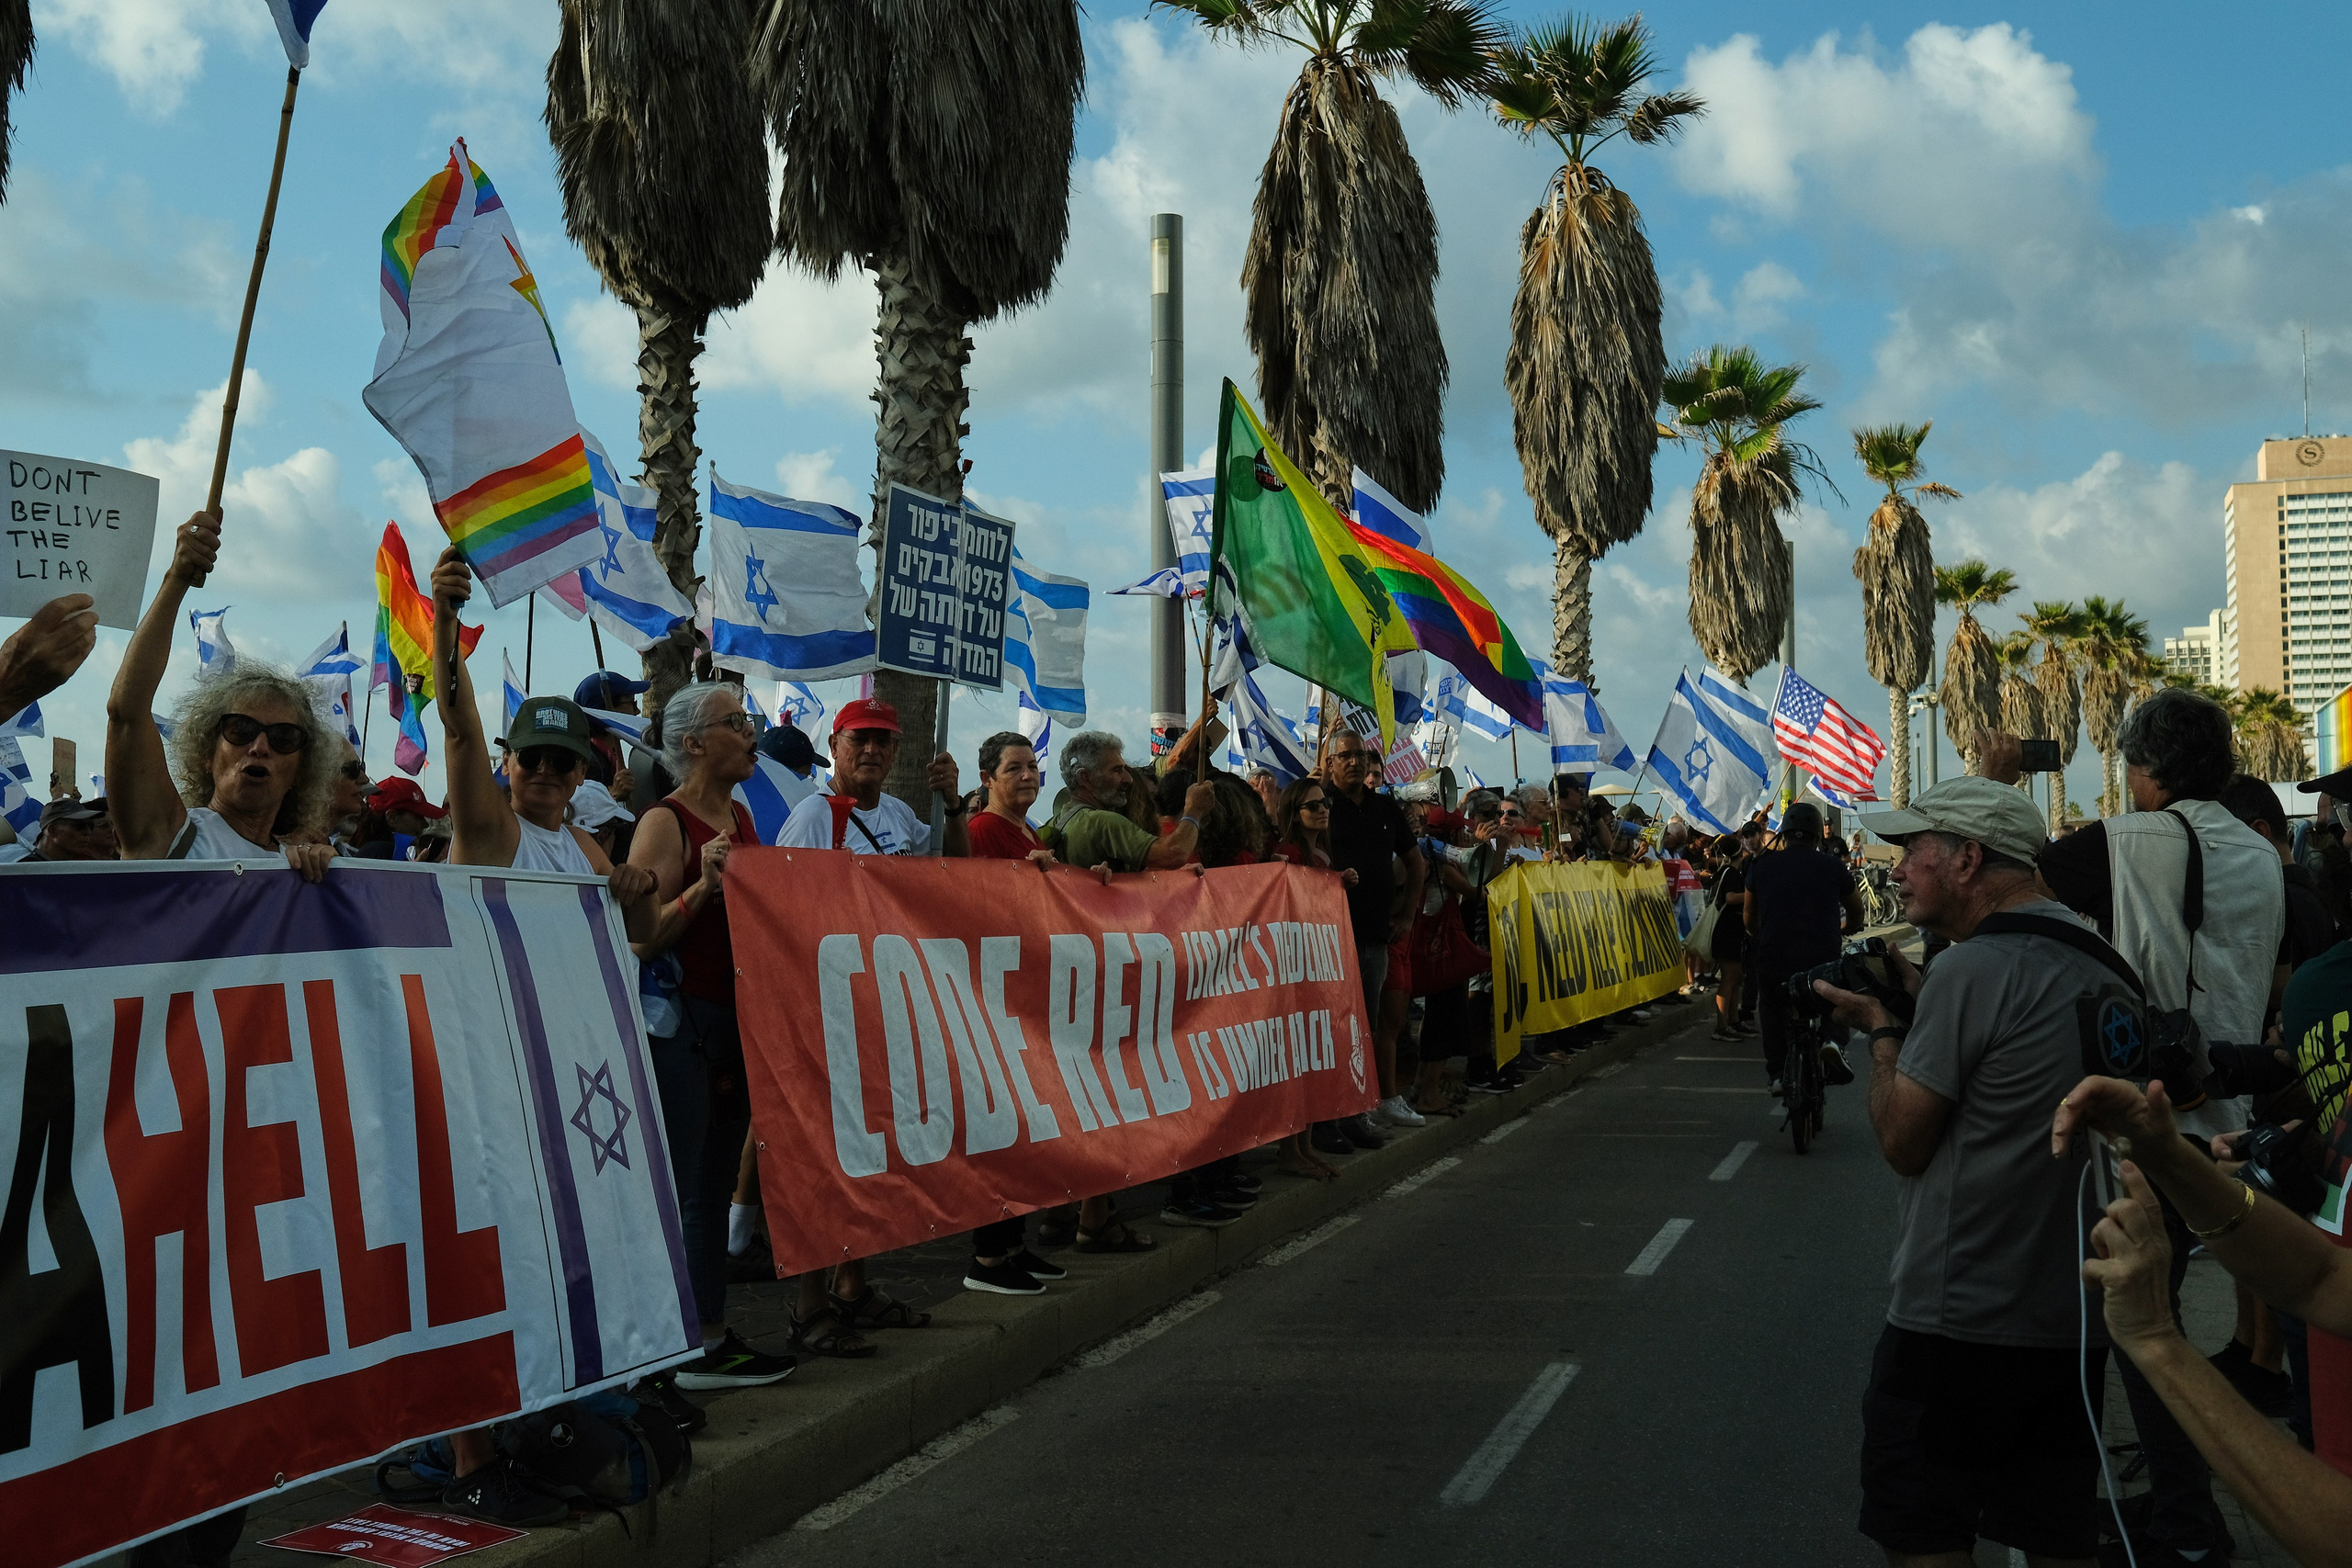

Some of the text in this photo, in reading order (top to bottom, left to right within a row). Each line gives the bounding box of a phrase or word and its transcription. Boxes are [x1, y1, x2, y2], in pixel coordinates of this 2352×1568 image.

[10, 459, 101, 495] DONT
[11, 500, 121, 530] BELIVE
[6, 529, 70, 550] THE
[17, 558, 93, 583] LIAR
[898, 543, 1003, 602] 1973 אבקים
[889, 575, 917, 618] של
[978, 600, 1001, 639] על
[1181, 921, 1275, 1001] ISRAEL'S
[818, 931, 1192, 1178] CODE RED
[1187, 1031, 1229, 1100] IS
[1216, 1016, 1289, 1093] UNDER
